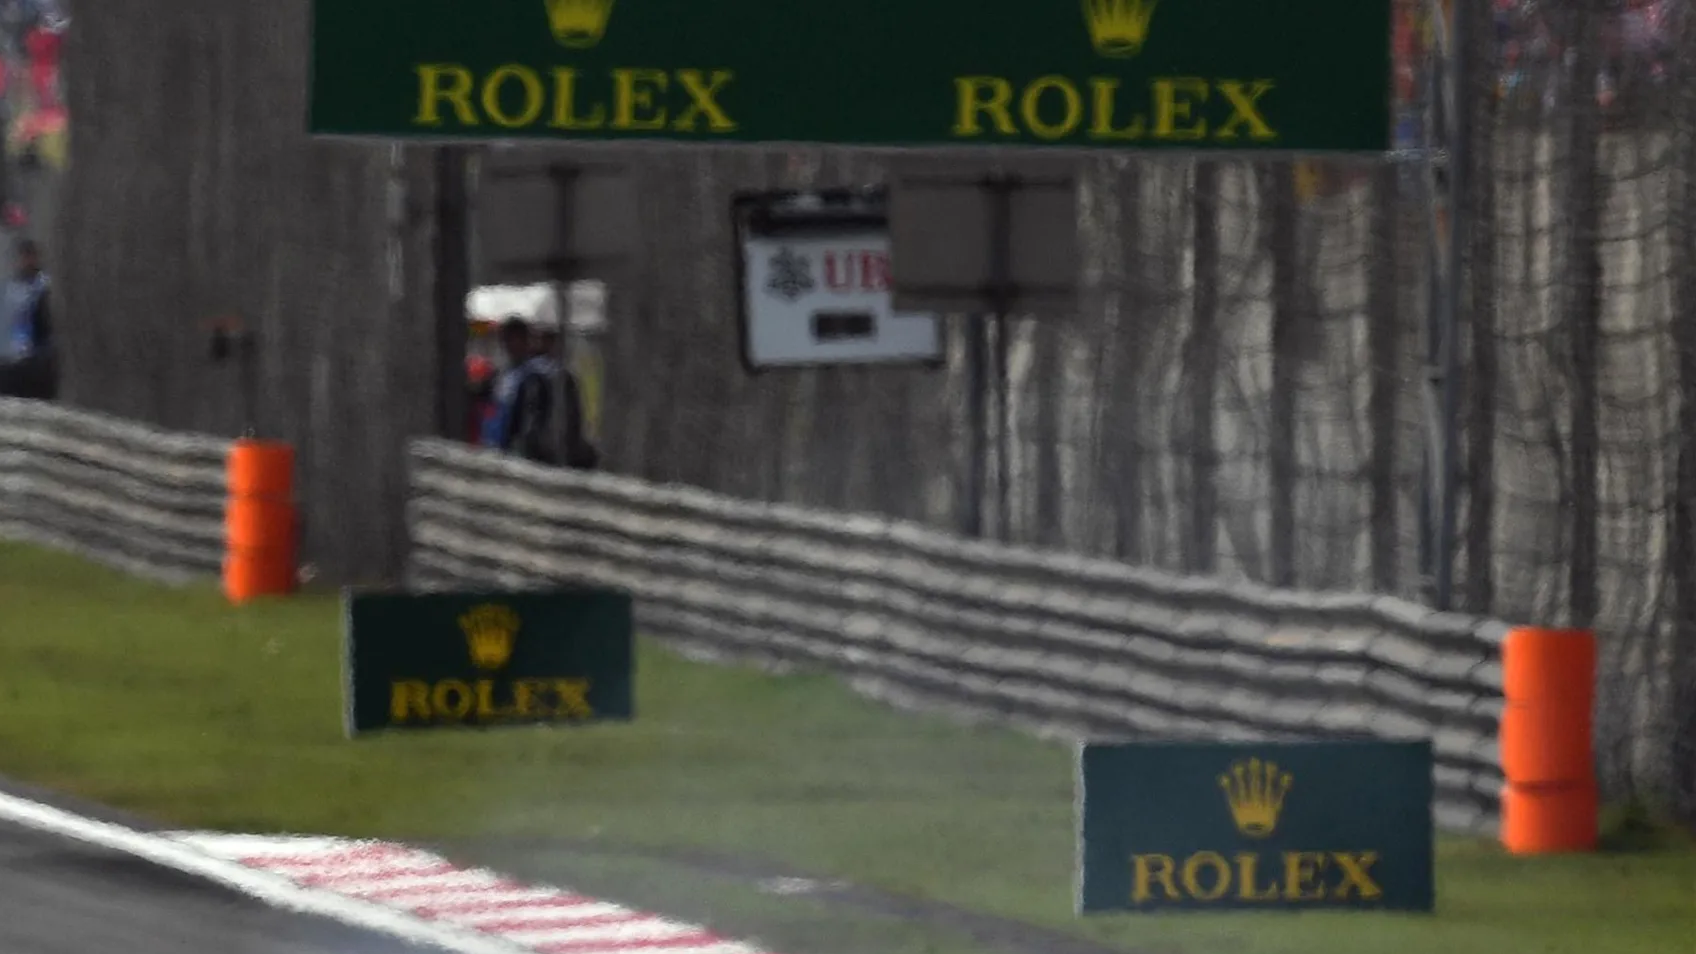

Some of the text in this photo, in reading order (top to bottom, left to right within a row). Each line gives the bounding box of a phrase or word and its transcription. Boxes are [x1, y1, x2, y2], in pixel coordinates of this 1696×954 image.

[412, 63, 738, 131] ROLEX
[952, 75, 1279, 139] ROLEX
[823, 249, 894, 291] UB
[390, 678, 594, 722] ROLEX
[1129, 850, 1384, 902] ROLEX
